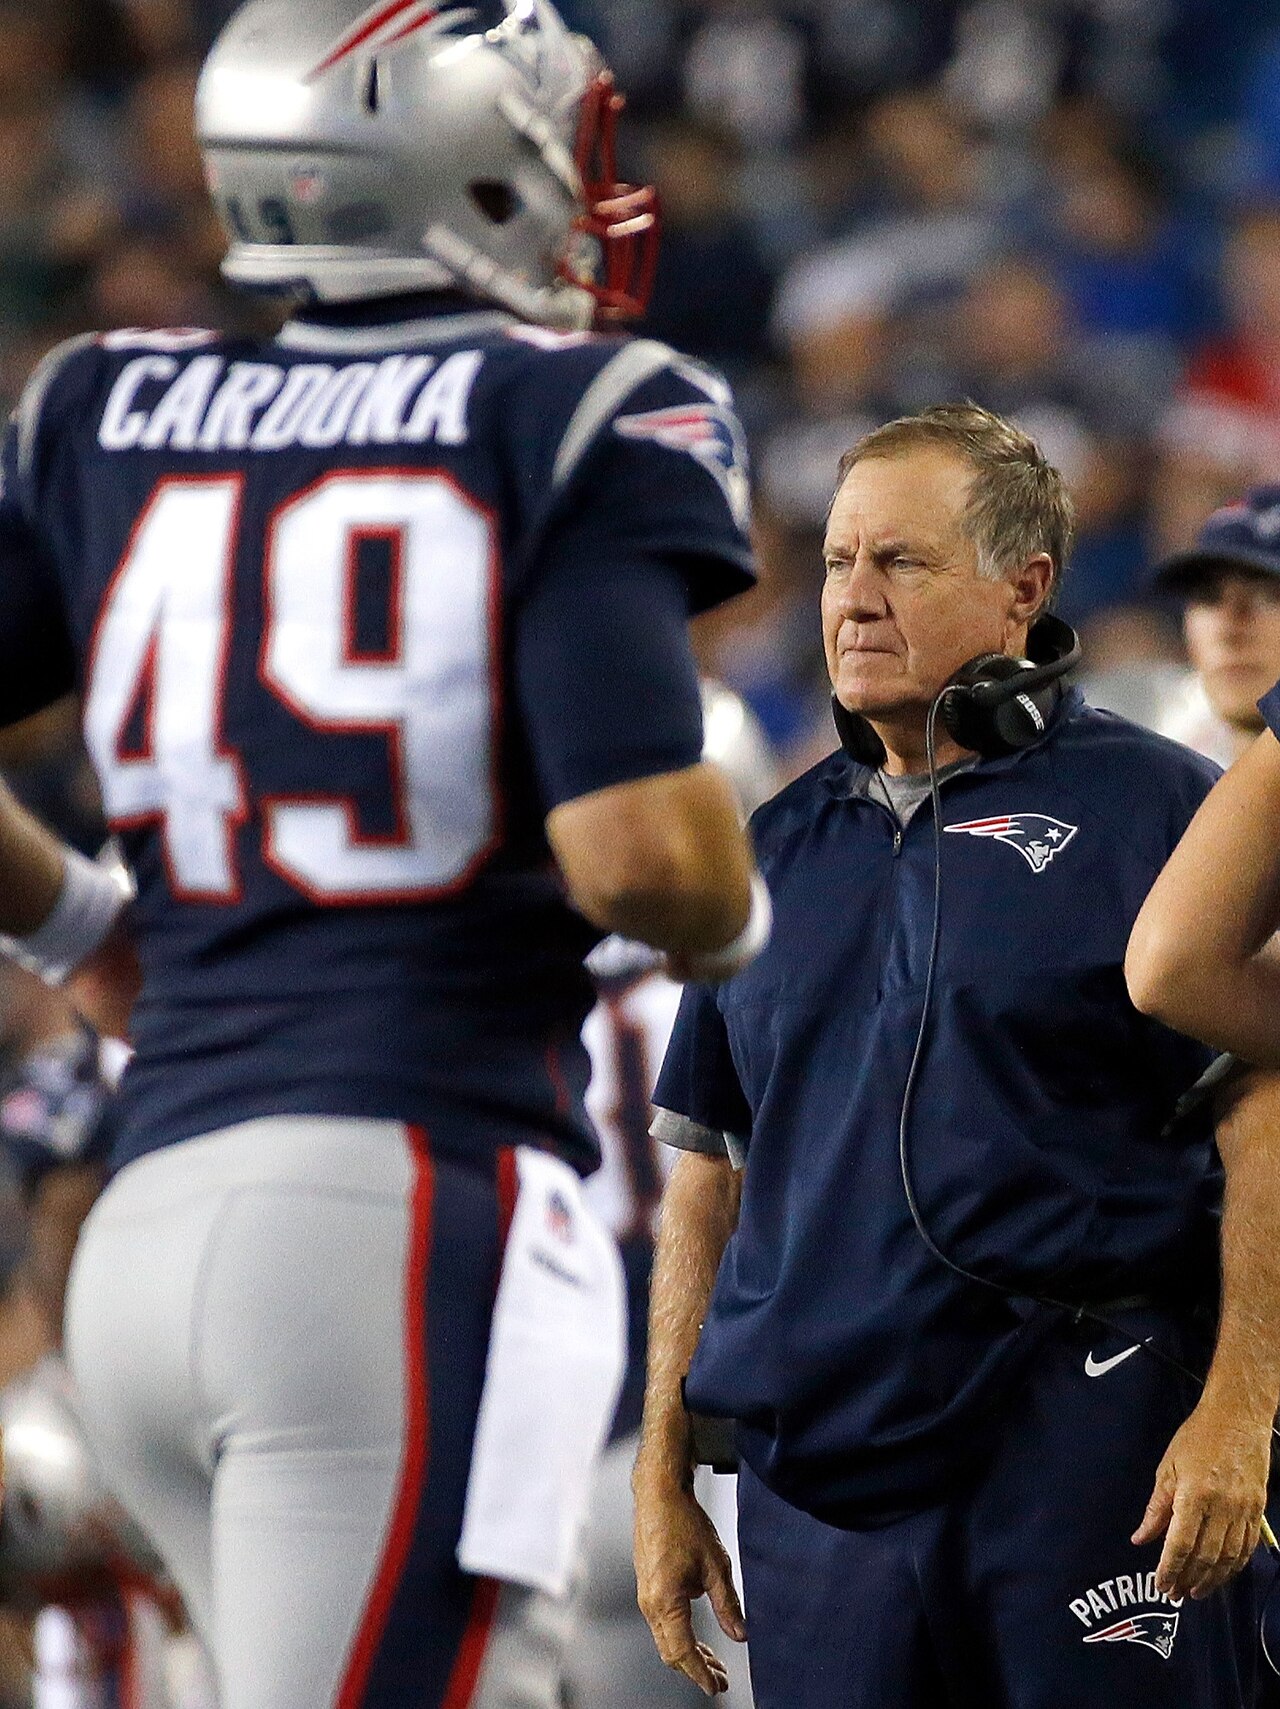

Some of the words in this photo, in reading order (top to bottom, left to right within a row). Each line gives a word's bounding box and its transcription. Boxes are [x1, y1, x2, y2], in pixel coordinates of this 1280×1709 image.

[99, 351, 485, 452] CARDONA
[83, 467, 501, 905] 49
[1016, 694, 1045, 730] BOSE
[1069, 1571, 1184, 1628] PATRIO
